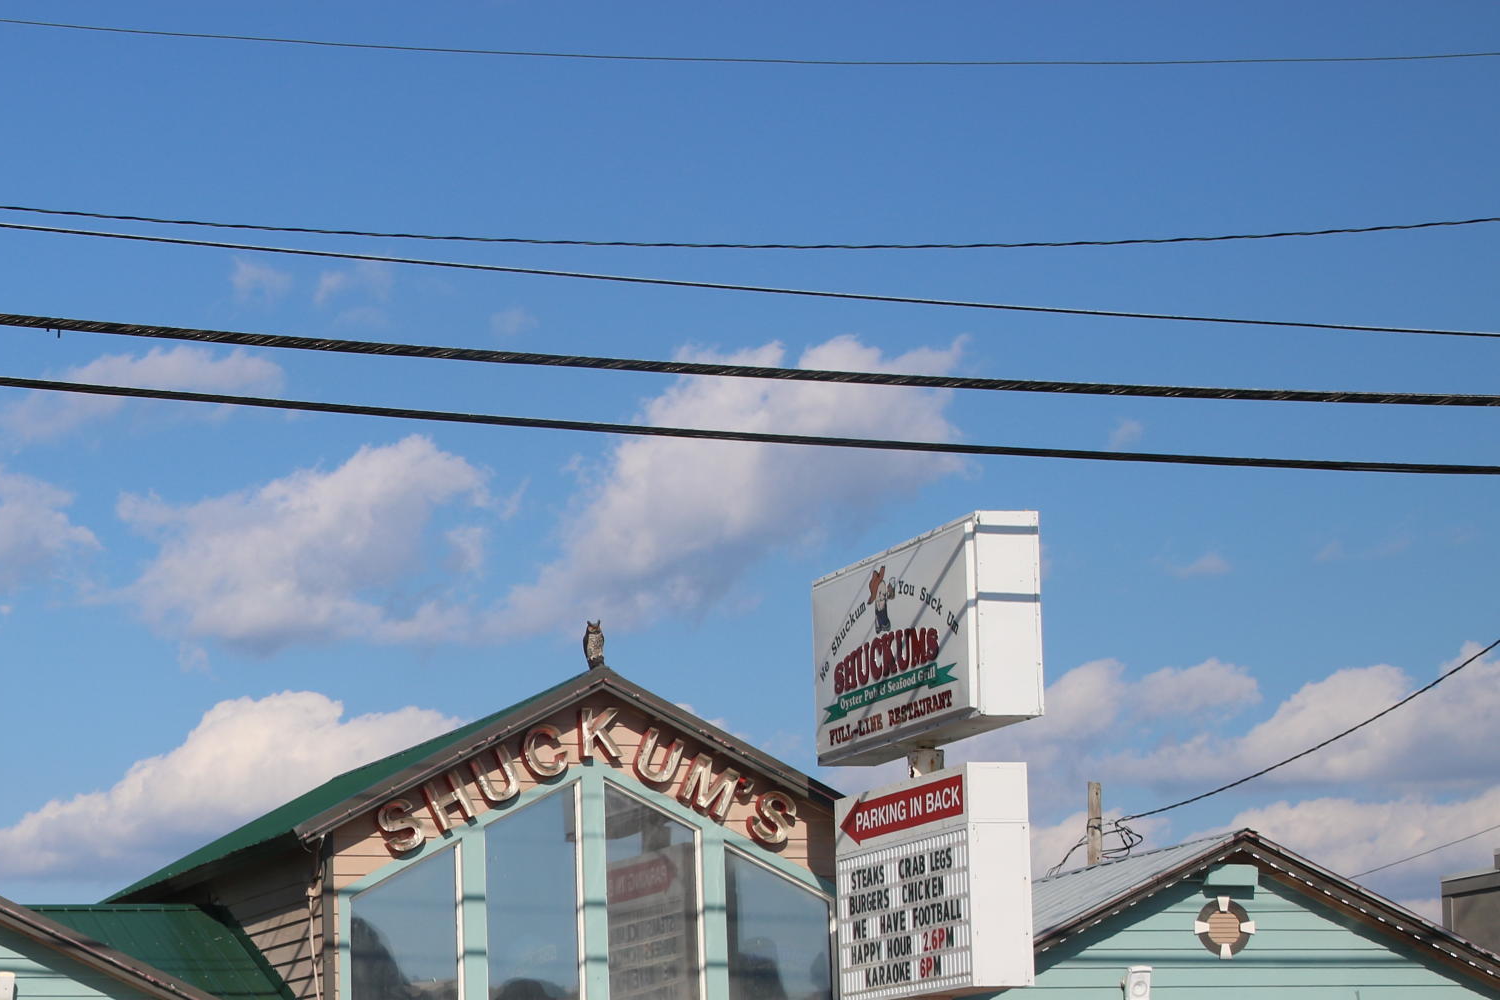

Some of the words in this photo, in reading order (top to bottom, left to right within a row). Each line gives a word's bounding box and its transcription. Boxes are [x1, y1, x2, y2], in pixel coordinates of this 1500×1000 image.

[820, 660, 830, 683] We
[831, 601, 867, 656] Shuckum
[898, 580, 915, 596] You
[919, 586, 943, 617] Suck
[946, 611, 959, 636] Um
[833, 627, 940, 696] SHUCKUMS
[839, 694, 863, 711] Oyster
[864, 687, 879, 702] Pub
[879, 683, 887, 696] &
[887, 676, 917, 695] Seafood
[917, 665, 937, 683] Grill
[829, 713, 884, 747] FULL-LINE
[887, 689, 953, 728] RESTAURANT
[377, 707, 798, 853] SHUCKUM'S
[855, 798, 907, 833] PARKING
[909, 796, 920, 818] IN
[925, 785, 961, 815] BACK
[850, 864, 886, 891] STEAKS
[898, 854, 926, 879] CRAB
[929, 847, 953, 871] LEGS
[849, 887, 891, 916] BURGERS
[901, 875, 945, 904] CHICKEN
[852, 919, 868, 940] WE
[880, 909, 907, 935] HAVE
[912, 898, 962, 929] FOOTBALL
[850, 941, 883, 966] HAPPY
[886, 934, 913, 957] HOUR
[923, 926, 955, 951] 2.6PM
[864, 960, 912, 988] KARAOKE
[919, 953, 943, 978] 6PM
